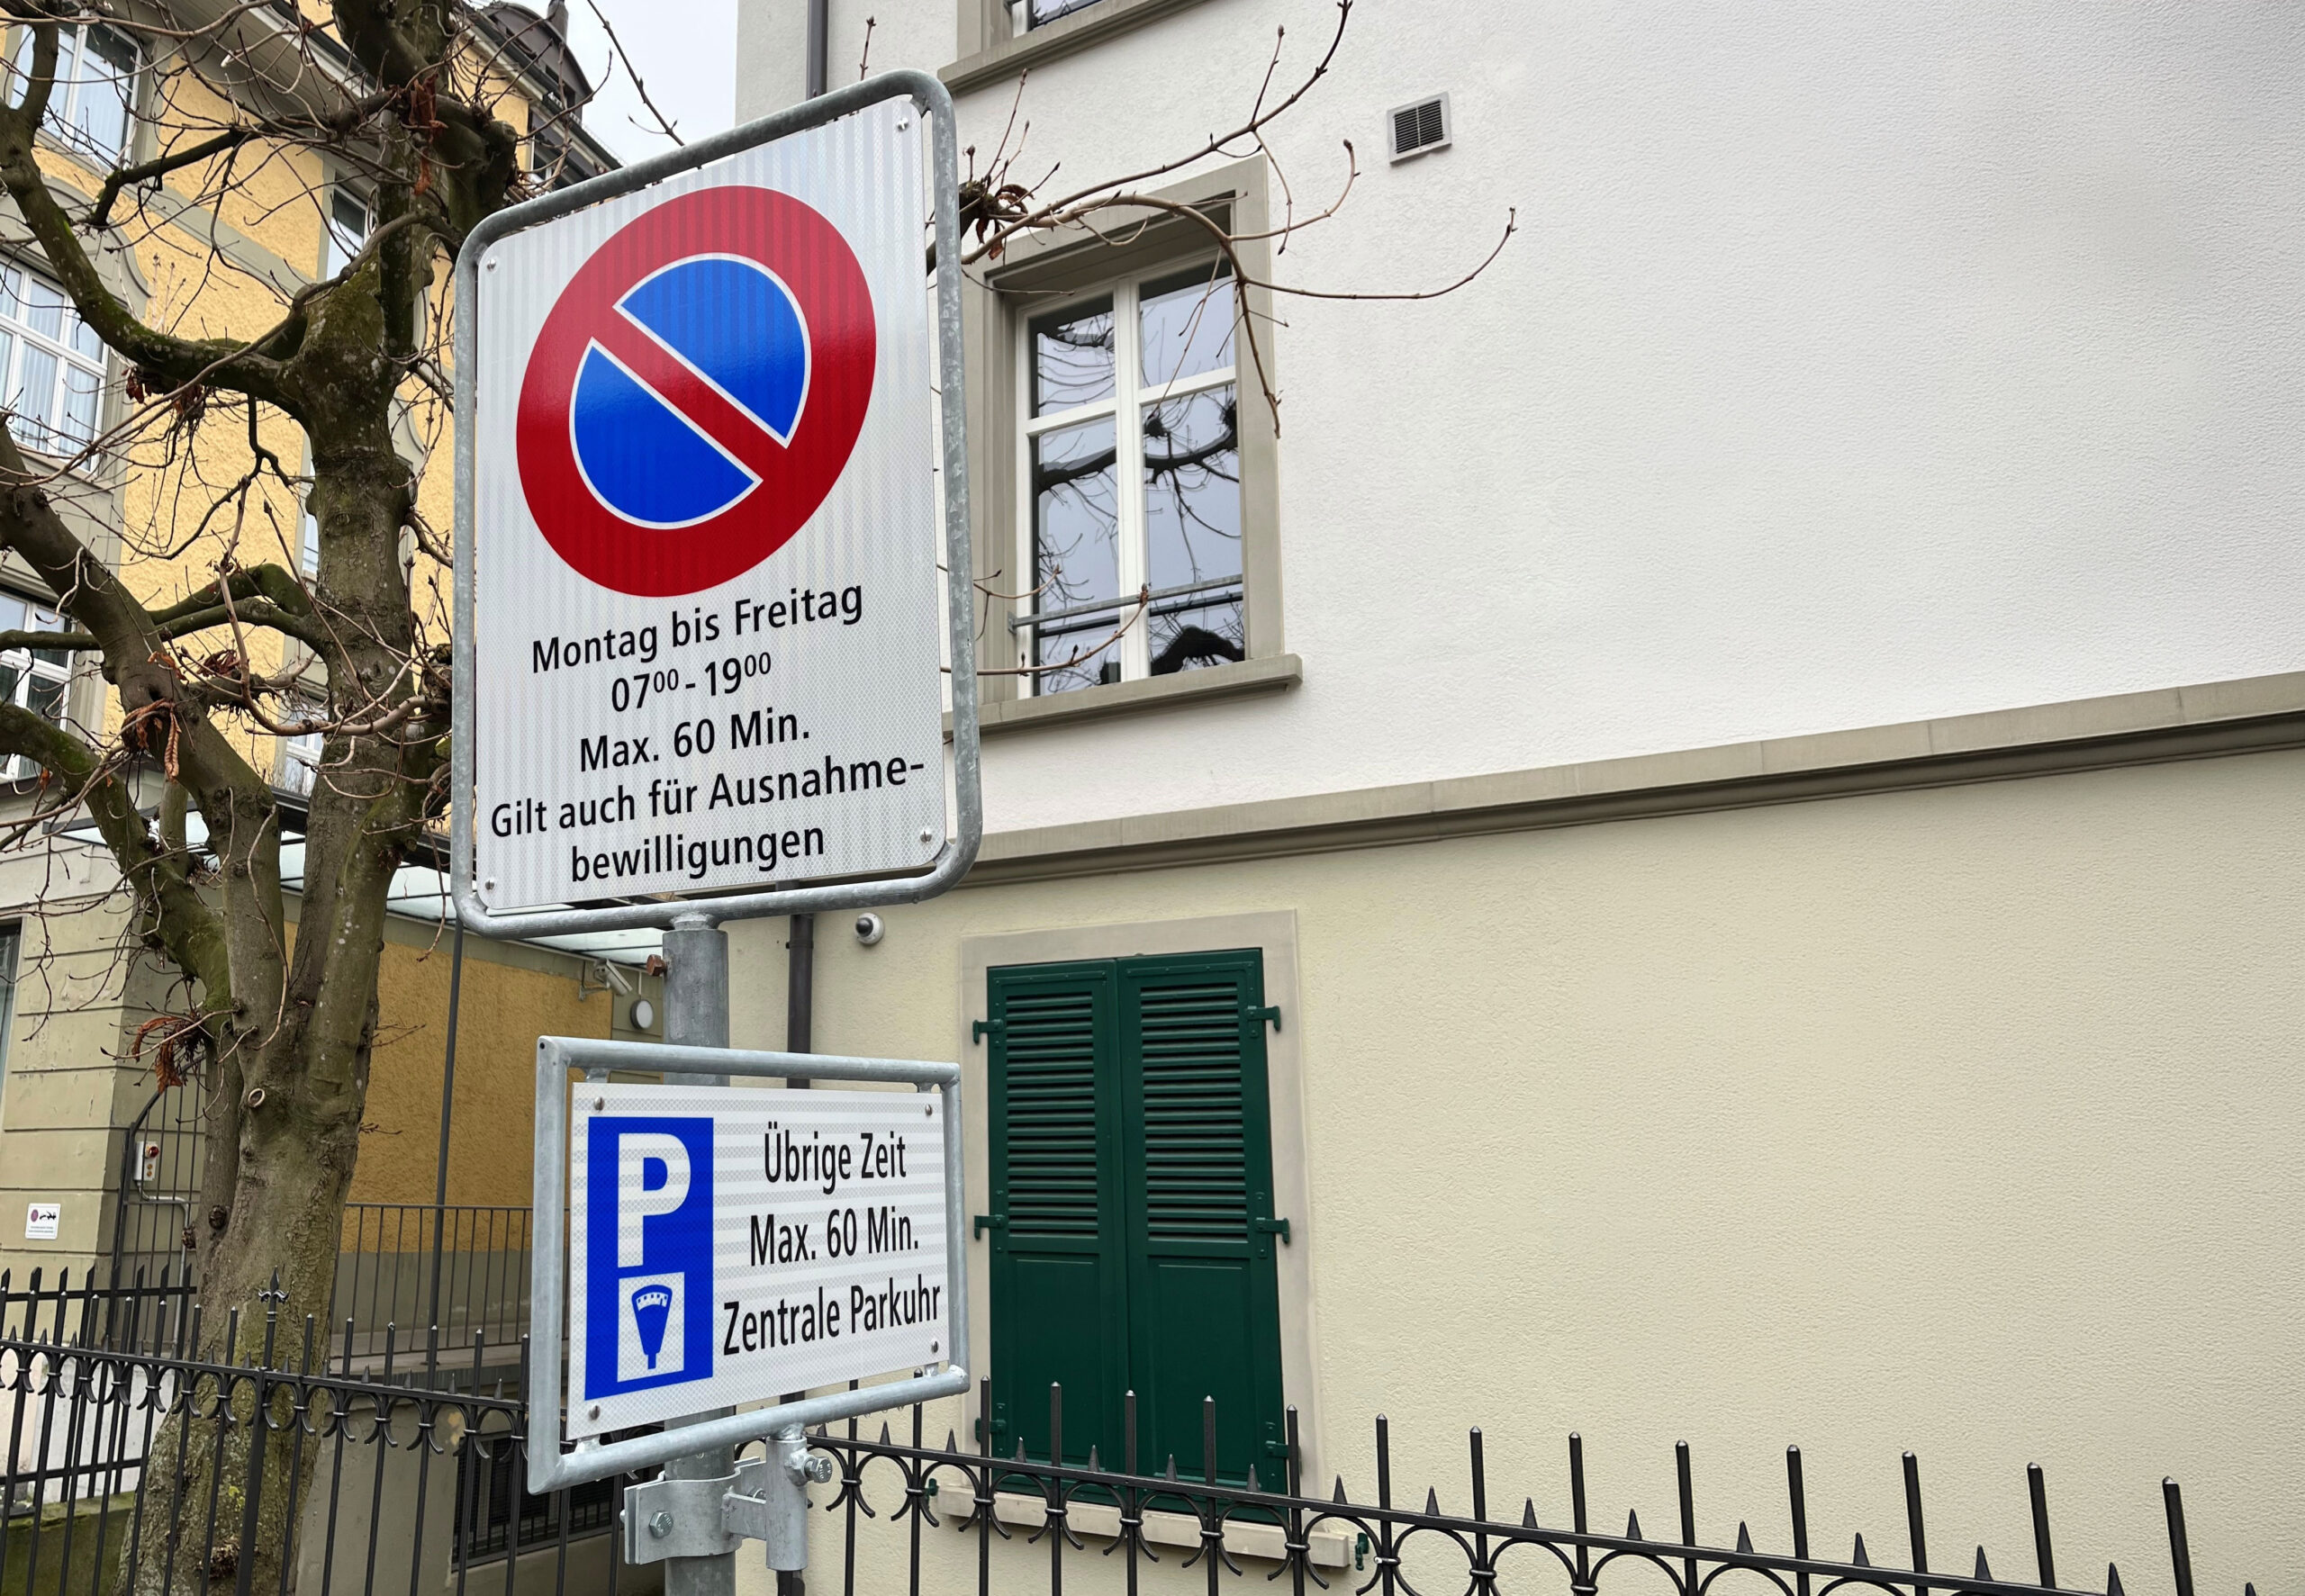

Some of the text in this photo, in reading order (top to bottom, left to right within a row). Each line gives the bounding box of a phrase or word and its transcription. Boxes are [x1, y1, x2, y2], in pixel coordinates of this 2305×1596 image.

[532, 585, 863, 674] Montag bis Freitag
[580, 707, 810, 772] Max. 60 Min.
[491, 754, 925, 838] Gilt auch für Ausnahme-
[571, 826, 825, 883] bewilligungen
[764, 1122, 907, 1195] Übrige Zeit
[617, 1132, 692, 1268] P
[749, 1205, 919, 1267] Max. 60 Min.
[723, 1273, 941, 1357] Zentrale Parkuhr
